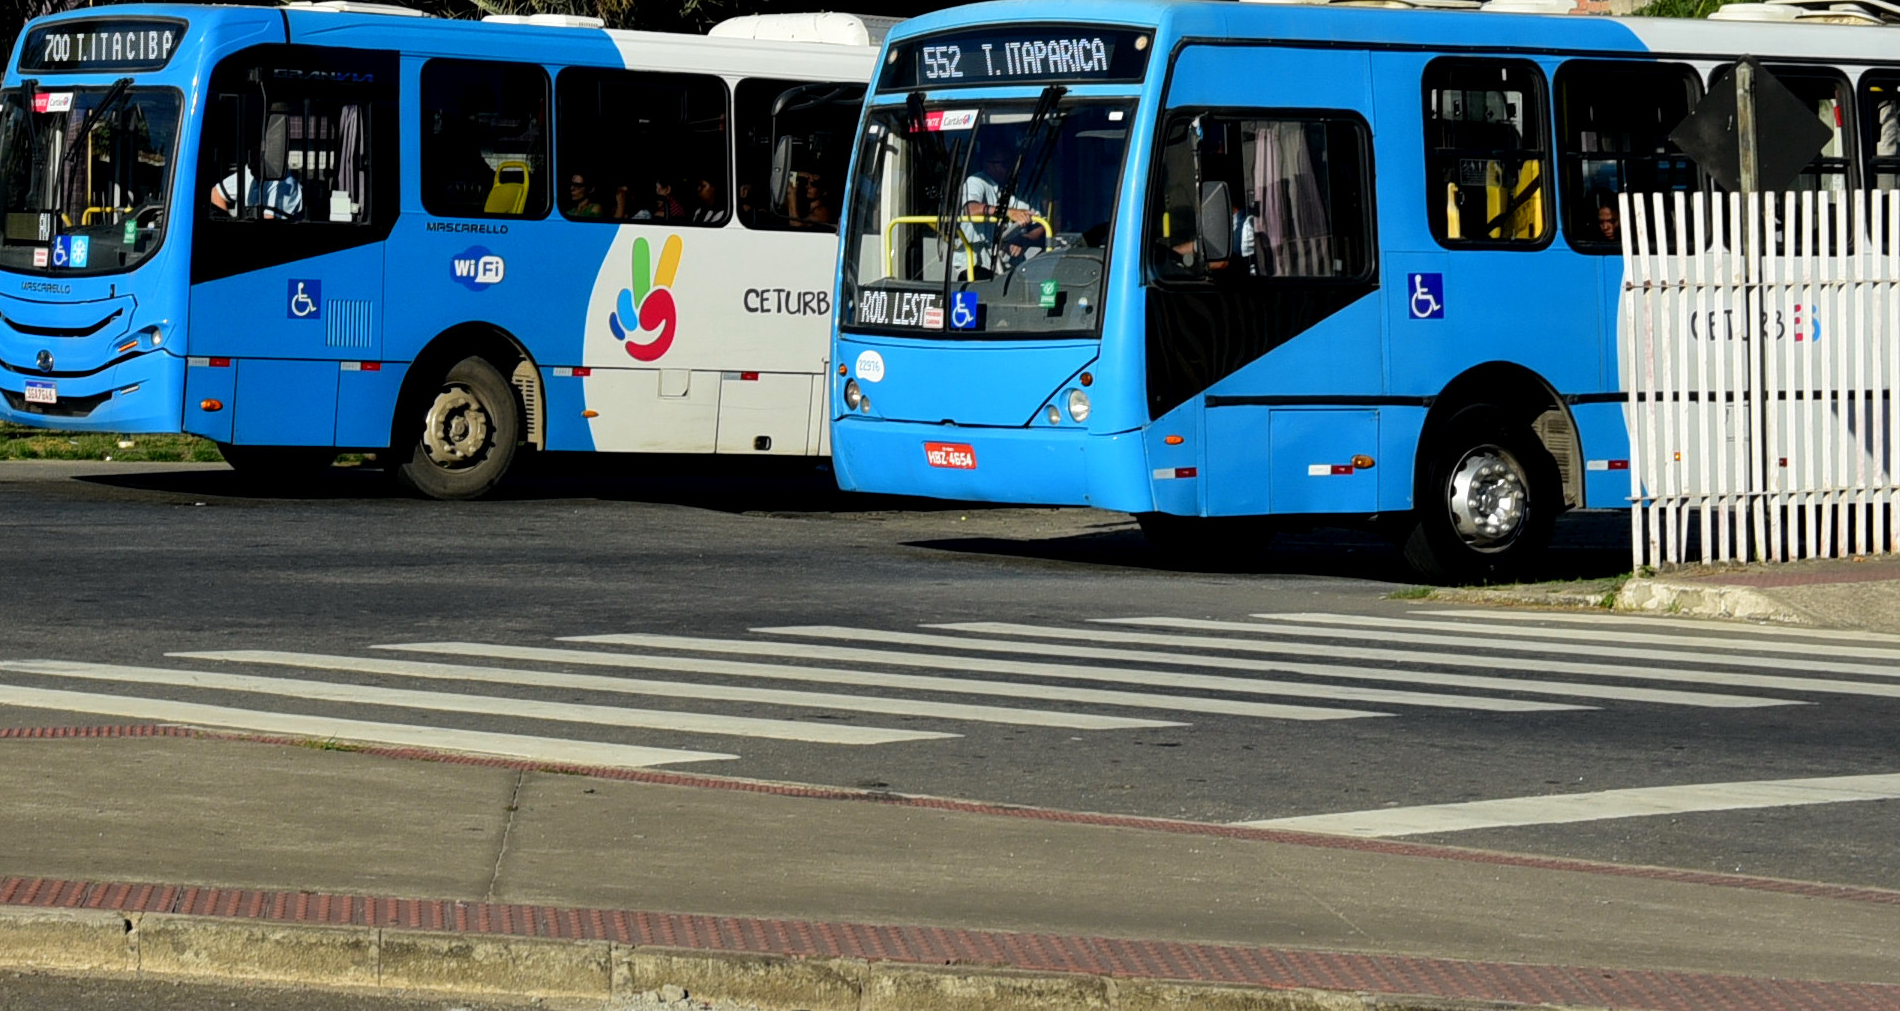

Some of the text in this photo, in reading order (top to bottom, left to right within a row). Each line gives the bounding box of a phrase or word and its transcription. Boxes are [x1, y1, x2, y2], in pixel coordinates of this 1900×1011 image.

[44, 34, 70, 62] 700
[923, 45, 963, 79] 552
[1005, 38, 1108, 75] ITAPARICA
[426, 221, 509, 235] MASCARELLO
[743, 288, 831, 316] CETURB
[858, 359, 881, 373] 22976
